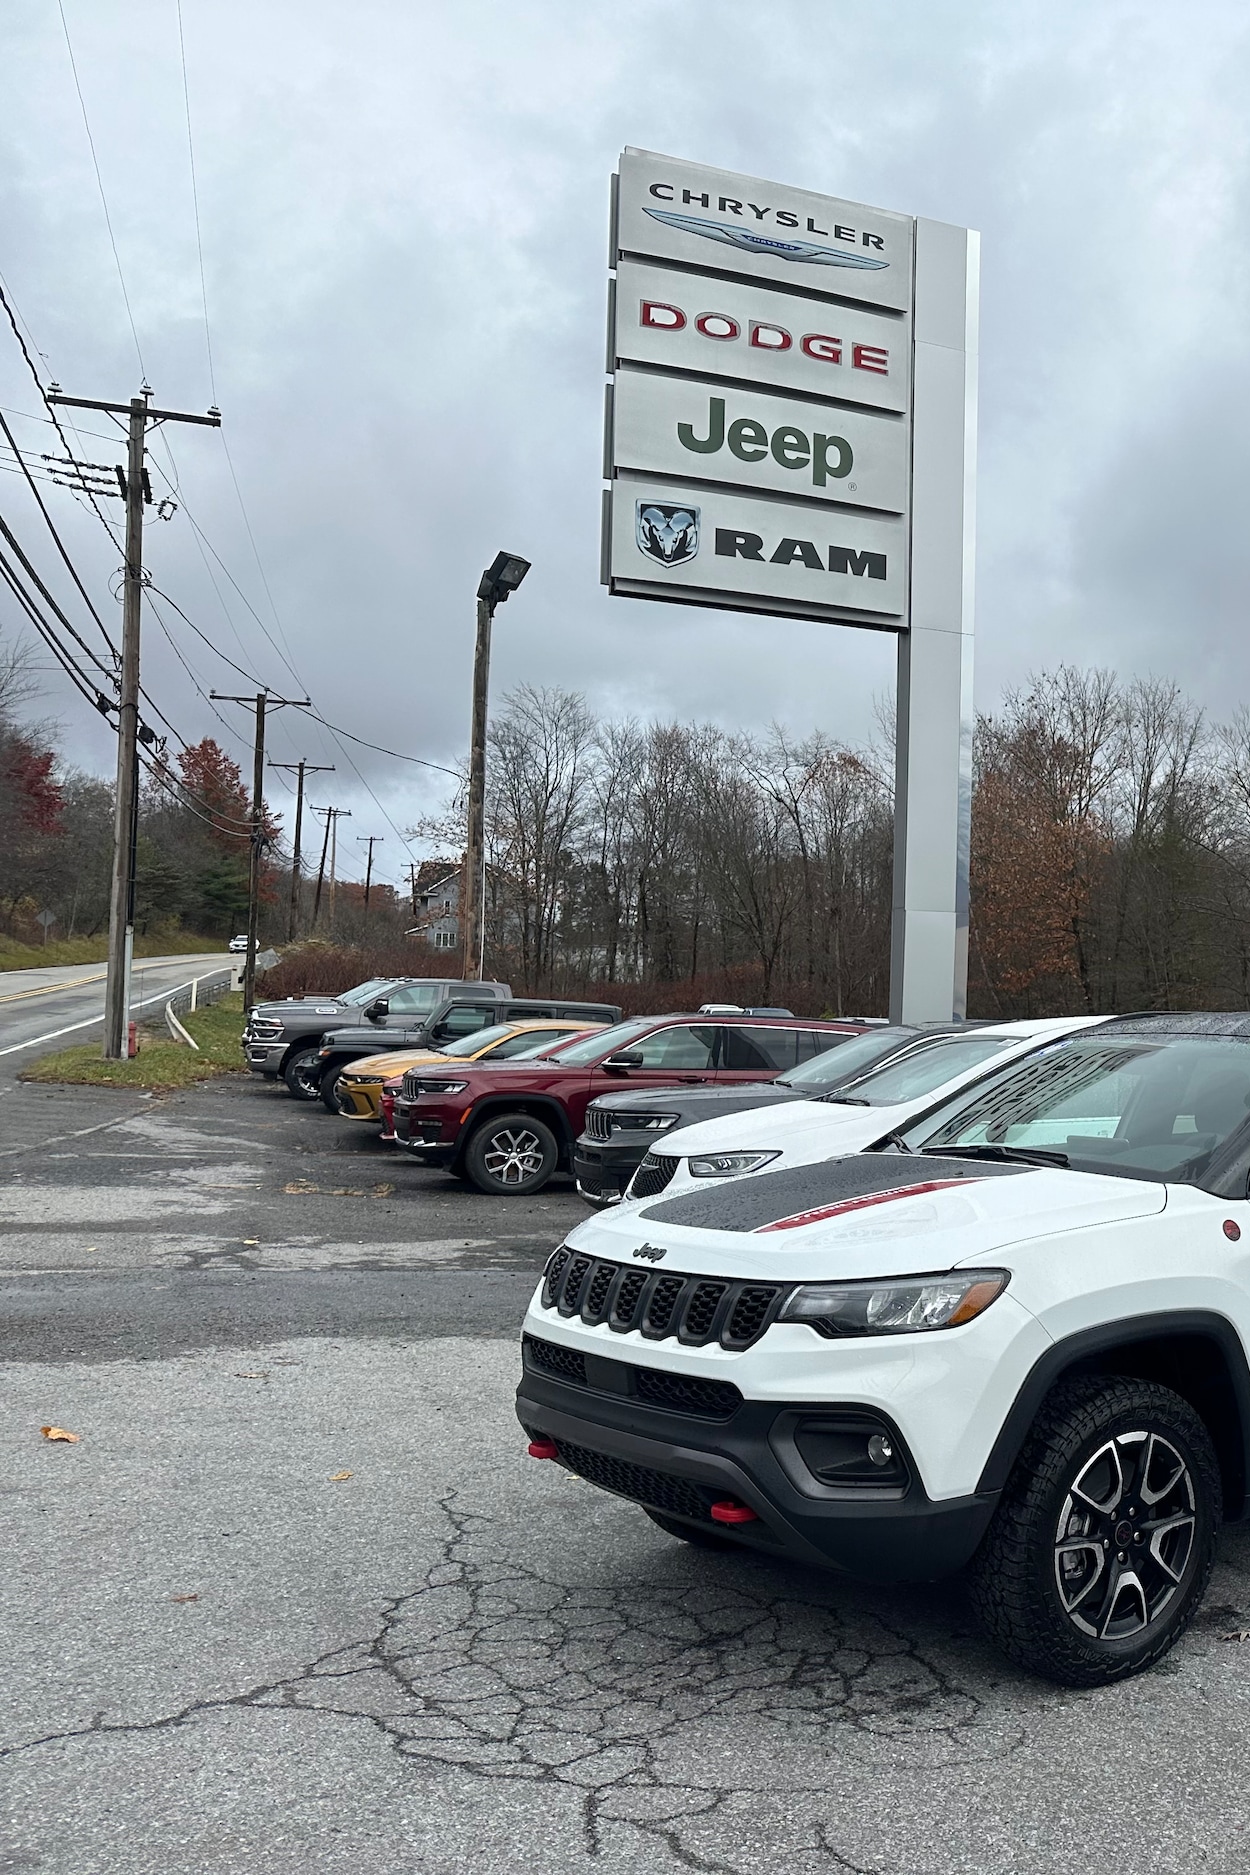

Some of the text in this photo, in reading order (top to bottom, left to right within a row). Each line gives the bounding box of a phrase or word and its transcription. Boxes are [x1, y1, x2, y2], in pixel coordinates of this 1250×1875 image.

[649, 182, 886, 251] CHRYSLER
[746, 236, 796, 250] CHRYSLER
[639, 299, 890, 376] DODGE
[677, 397, 854, 487] Jeep
[714, 527, 888, 581] RAM
[632, 1242, 668, 1263] Jeep
